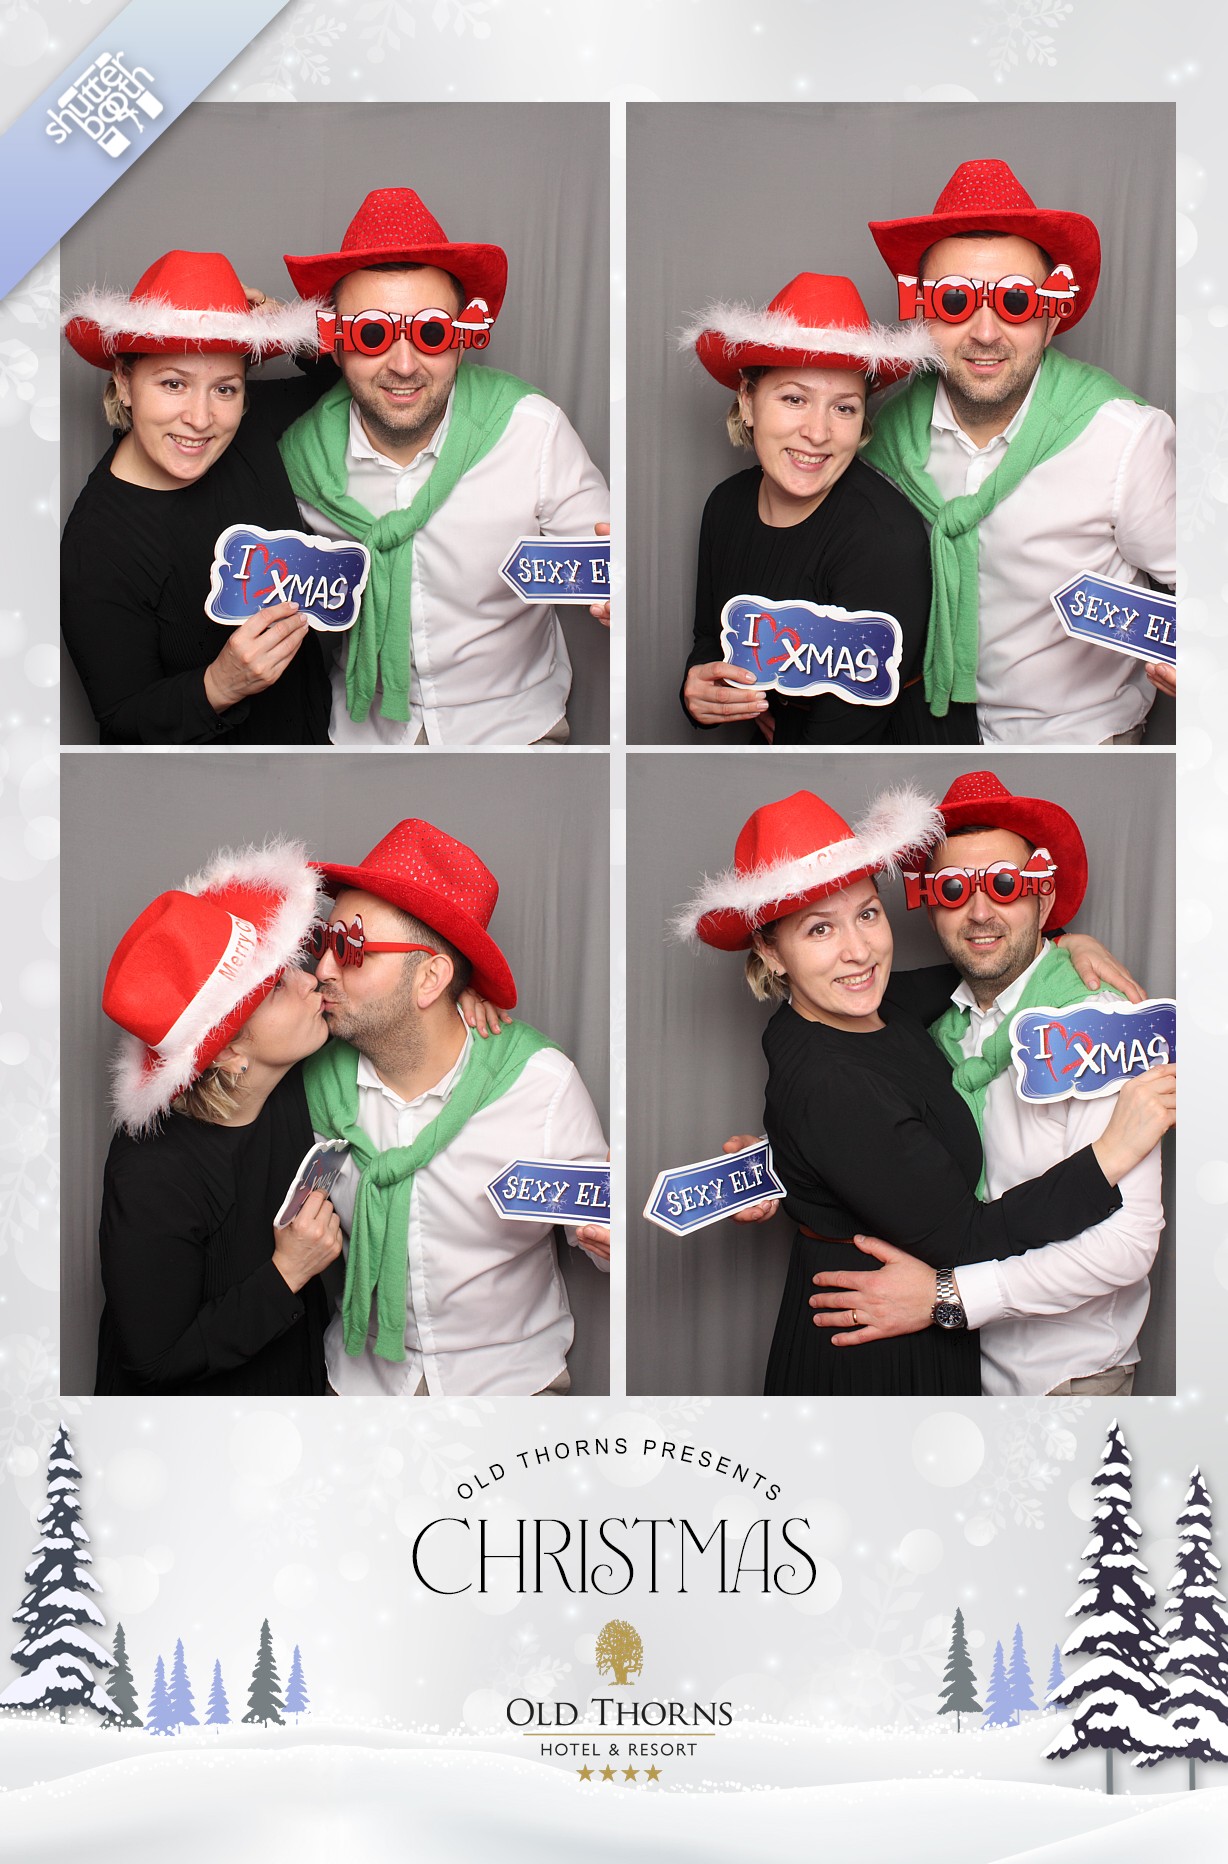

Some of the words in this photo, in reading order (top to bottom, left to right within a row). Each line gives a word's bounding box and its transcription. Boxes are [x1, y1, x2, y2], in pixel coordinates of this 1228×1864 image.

[233, 544, 257, 580] I
[262, 569, 348, 610] XMAS
[517, 557, 582, 585] SEXY
[1069, 590, 1140, 631] SEXY
[741, 613, 762, 647] I
[778, 638, 878, 683] XMAS
[218, 932, 256, 982] Merry
[1033, 1024, 1053, 1060] I
[1073, 1036, 1170, 1078] XMAS
[502, 1175, 570, 1203] SEXY
[574, 1182, 610, 1208] EL
[666, 1178, 724, 1217] SEXY
[728, 1163, 765, 1194] ELF
